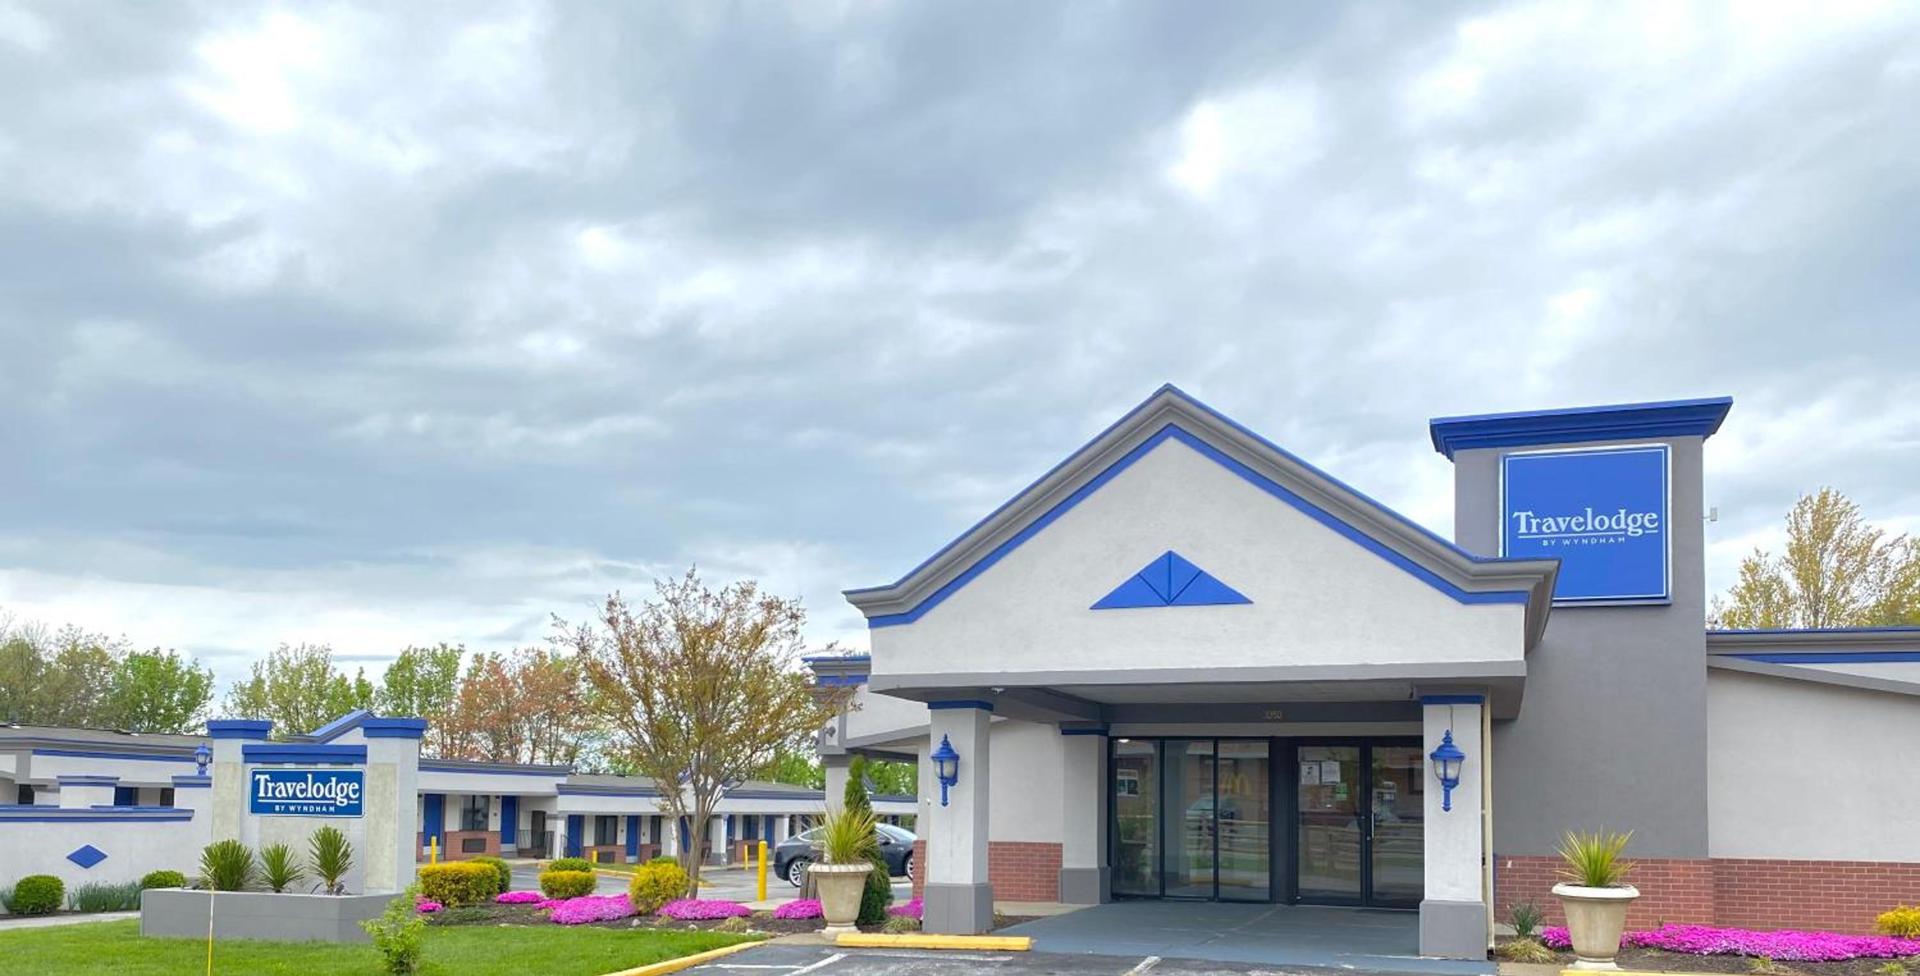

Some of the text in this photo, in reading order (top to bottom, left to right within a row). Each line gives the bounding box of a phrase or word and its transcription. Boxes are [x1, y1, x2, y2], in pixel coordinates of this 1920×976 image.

[1512, 507, 1659, 537] Travelodge
[1542, 536, 1626, 547] BY WYNDHAM
[254, 773, 360, 807] Travelodge
[274, 804, 336, 813] BY WYNDHAM
